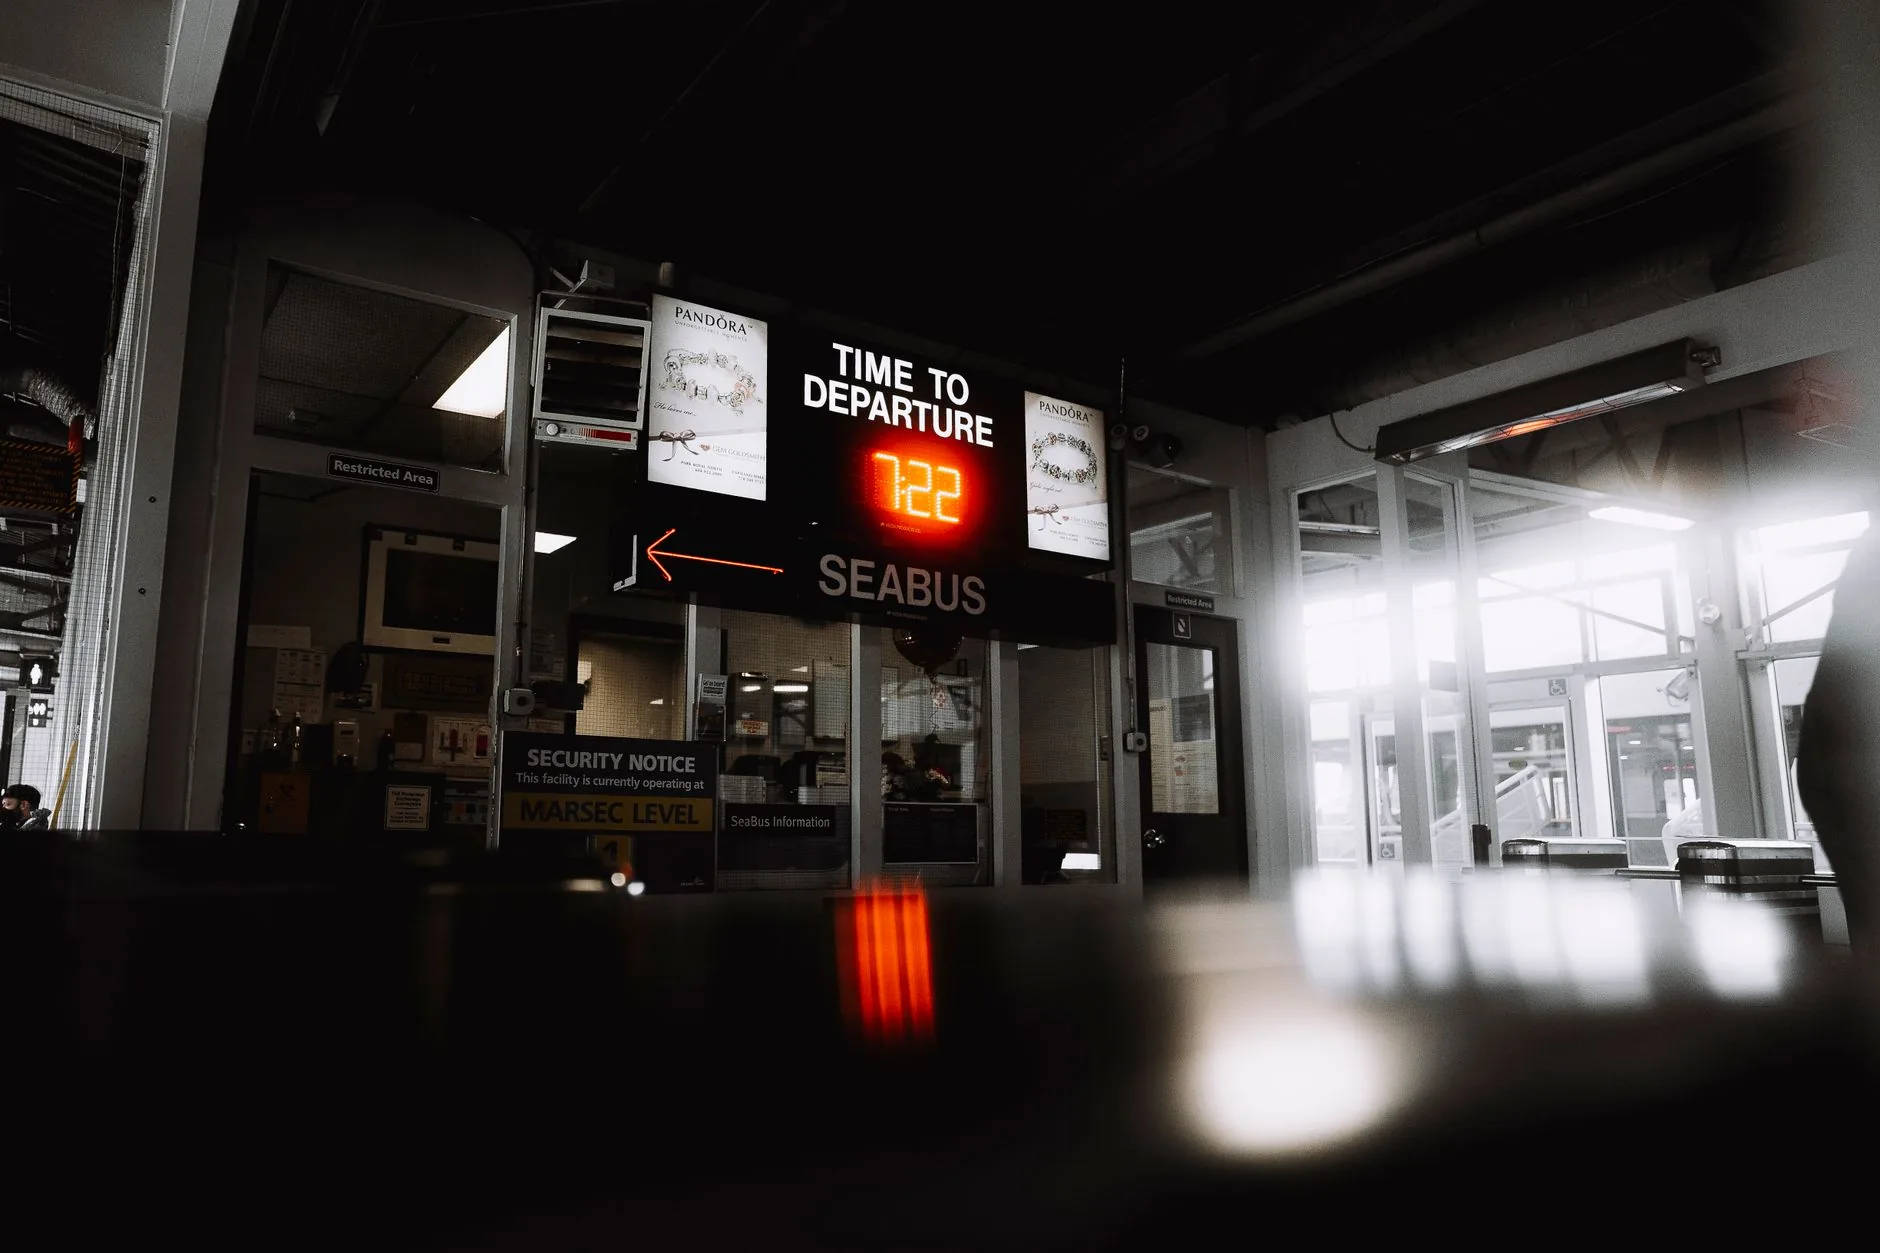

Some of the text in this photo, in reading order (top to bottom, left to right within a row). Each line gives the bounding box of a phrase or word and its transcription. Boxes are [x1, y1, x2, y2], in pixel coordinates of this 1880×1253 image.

[675, 306, 748, 335] PANDORA
[832, 342, 970, 406] TIME TO
[804, 373, 994, 448] DEPARTURE
[1039, 401, 1090, 423] PANDORA
[334, 460, 434, 485] Restricted Area
[874, 452, 961, 523] 7:22
[818, 554, 986, 615] SEABUS
[1167, 594, 1213, 609] Restricted Area
[527, 749, 696, 773] SECURITY NOTICE
[516, 772, 704, 792] This facility is currently operating at
[520, 799, 700, 825] MARSEC LEVEL
[730, 816, 830, 828] SeaBus Information
